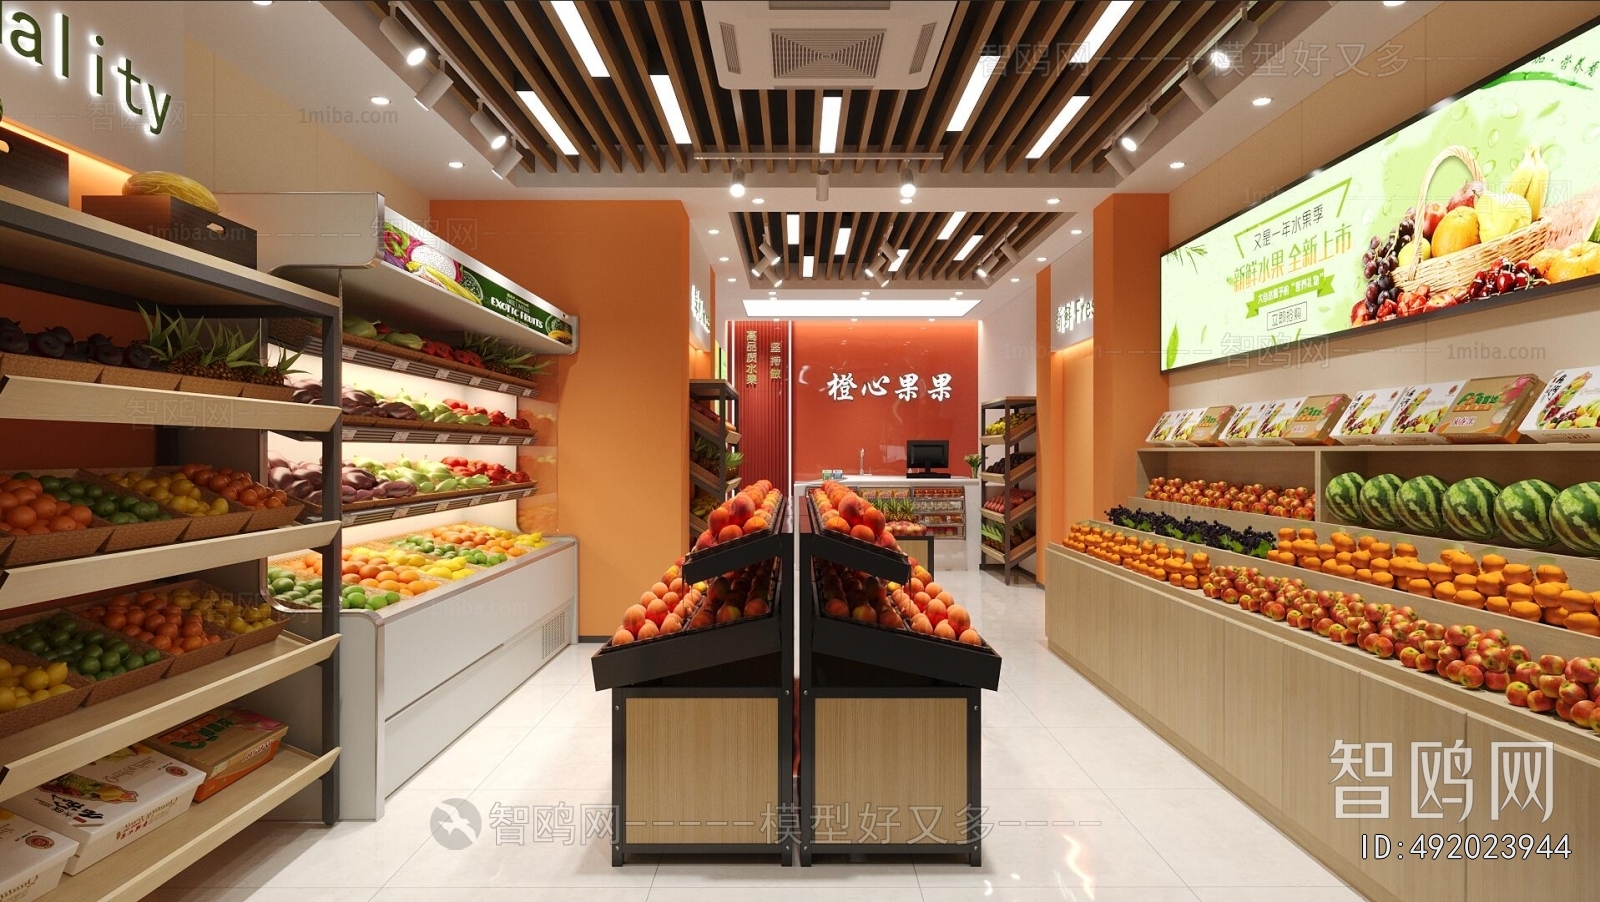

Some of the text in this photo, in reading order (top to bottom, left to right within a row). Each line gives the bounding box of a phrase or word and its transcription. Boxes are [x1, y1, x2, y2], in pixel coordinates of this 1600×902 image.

[0, 11, 171, 134] ality
[1254, 204, 1324, 251] 又是一年水果季
[1233, 223, 1352, 292] 新鲜水果 全新上市
[490, 296, 520, 318] EXOTIC
[519, 310, 544, 329] FRUITS
[745, 330, 758, 386] 高品质水果
[826, 372, 953, 402] 橙心果果
